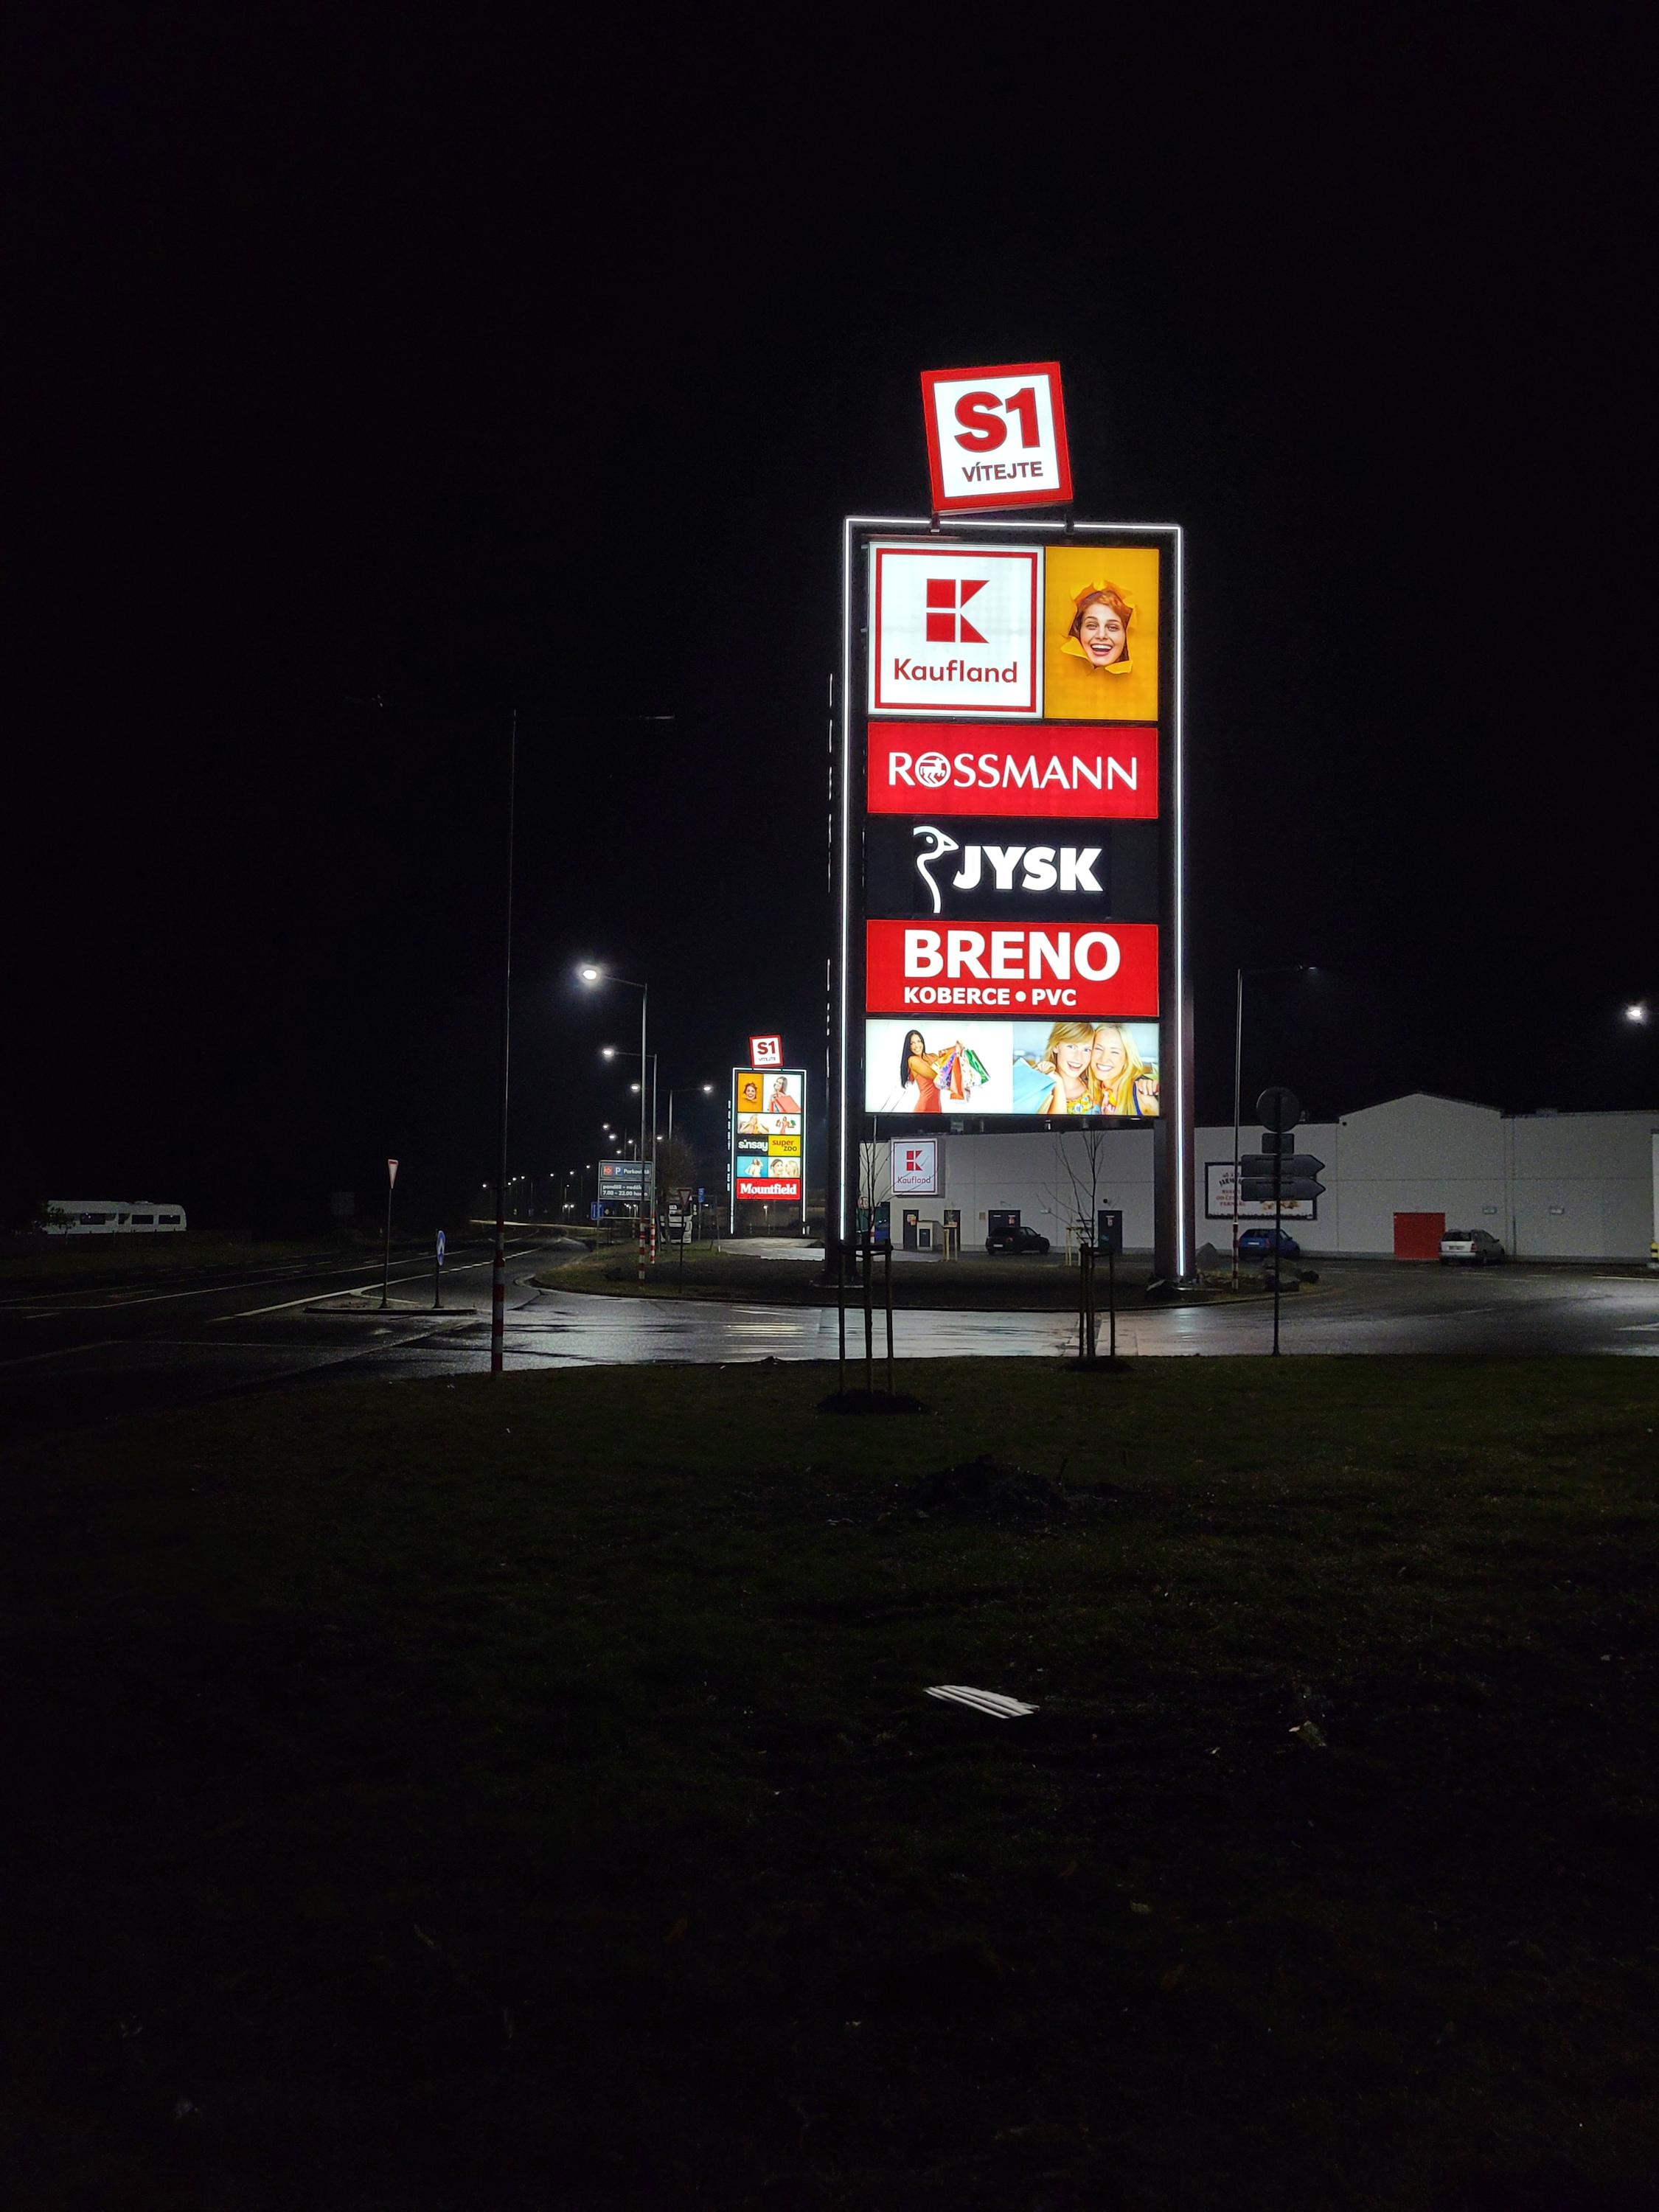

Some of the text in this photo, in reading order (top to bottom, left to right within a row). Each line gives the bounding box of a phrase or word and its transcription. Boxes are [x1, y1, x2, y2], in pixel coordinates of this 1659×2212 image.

[954, 387, 1041, 453] S1
[961, 462, 1043, 482] VÍTEJTE
[894, 658, 1018, 684] Kaufland
[888, 751, 1138, 790] ROSSMANN
[953, 845, 1103, 891] JYSK
[904, 929, 1121, 981] BRENO
[904, 987, 1077, 1006] KOBERCE PVC
[757, 1040, 776, 1055] S1
[738, 1139, 768, 1152] sinsay
[740, 1183, 797, 1194] Mountfield
[897, 1176, 931, 1184] Kaufland
